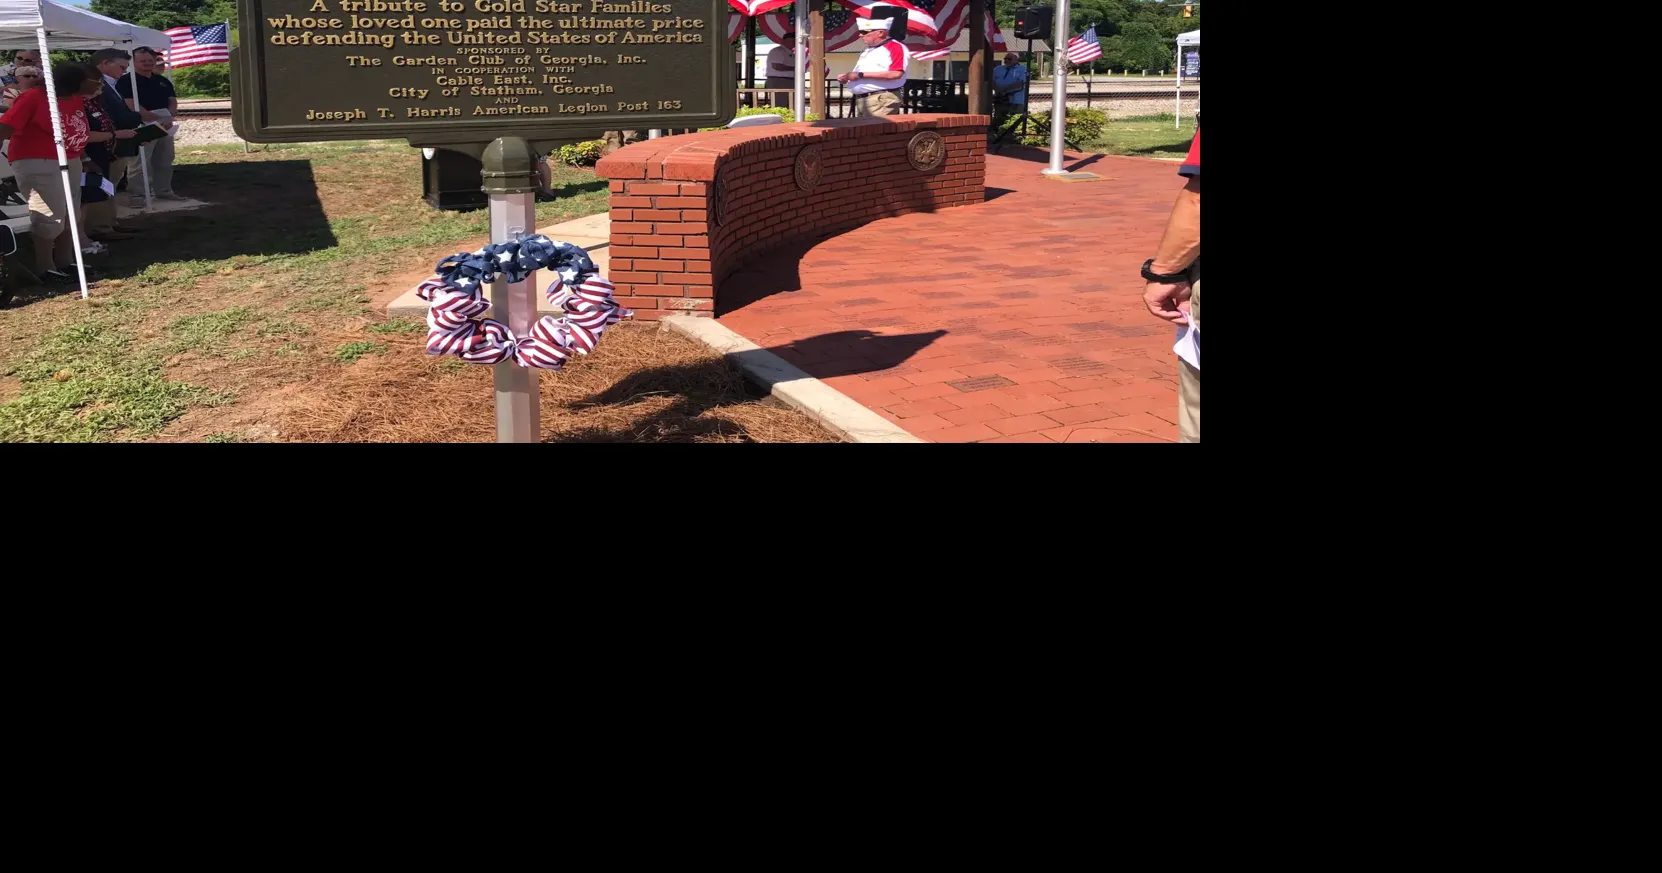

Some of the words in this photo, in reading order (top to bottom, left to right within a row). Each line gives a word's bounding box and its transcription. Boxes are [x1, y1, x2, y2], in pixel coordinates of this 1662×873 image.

[310, 0, 329, 11] A
[340, 0, 427, 11] tribute
[439, 0, 464, 11] to
[475, 0, 525, 12] Gold
[536, 0, 582, 13] Star
[591, 0, 672, 13] Families
[268, 14, 343, 28] whose
[351, 15, 415, 28] loved
[421, 18, 462, 28] one
[466, 16, 512, 32] paid
[517, 16, 553, 28] the
[558, 16, 646, 29] ultimate
[652, 17, 704, 31] price
[270, 31, 395, 48] defending
[401, 31, 440, 45] the
[447, 31, 522, 44] United
[527, 31, 590, 44] States
[595, 31, 618, 44] of
[621, 31, 703, 44] America
[456, 47, 525, 55] SPONSORED
[346, 56, 382, 66] The
[392, 55, 457, 66] Garden
[468, 55, 505, 65] Club
[514, 55, 531, 65] of
[617, 54, 646, 64] Inc.
[431, 67, 445, 75] IN
[454, 66, 535, 74] COOPERATION
[436, 75, 483, 86] Cable
[542, 74, 572, 84] Inc.
[388, 87, 429, 99] City
[441, 86, 459, 97] of
[552, 84, 614, 95] Georgia
[306, 109, 367, 121] Joseph
[377, 107, 395, 118] T.
[407, 106, 461, 118] Harris
[472, 105, 549, 116] American
[559, 102, 608, 114] Legion
[617, 101, 649, 111] Post
[657, 100, 682, 110] 163
